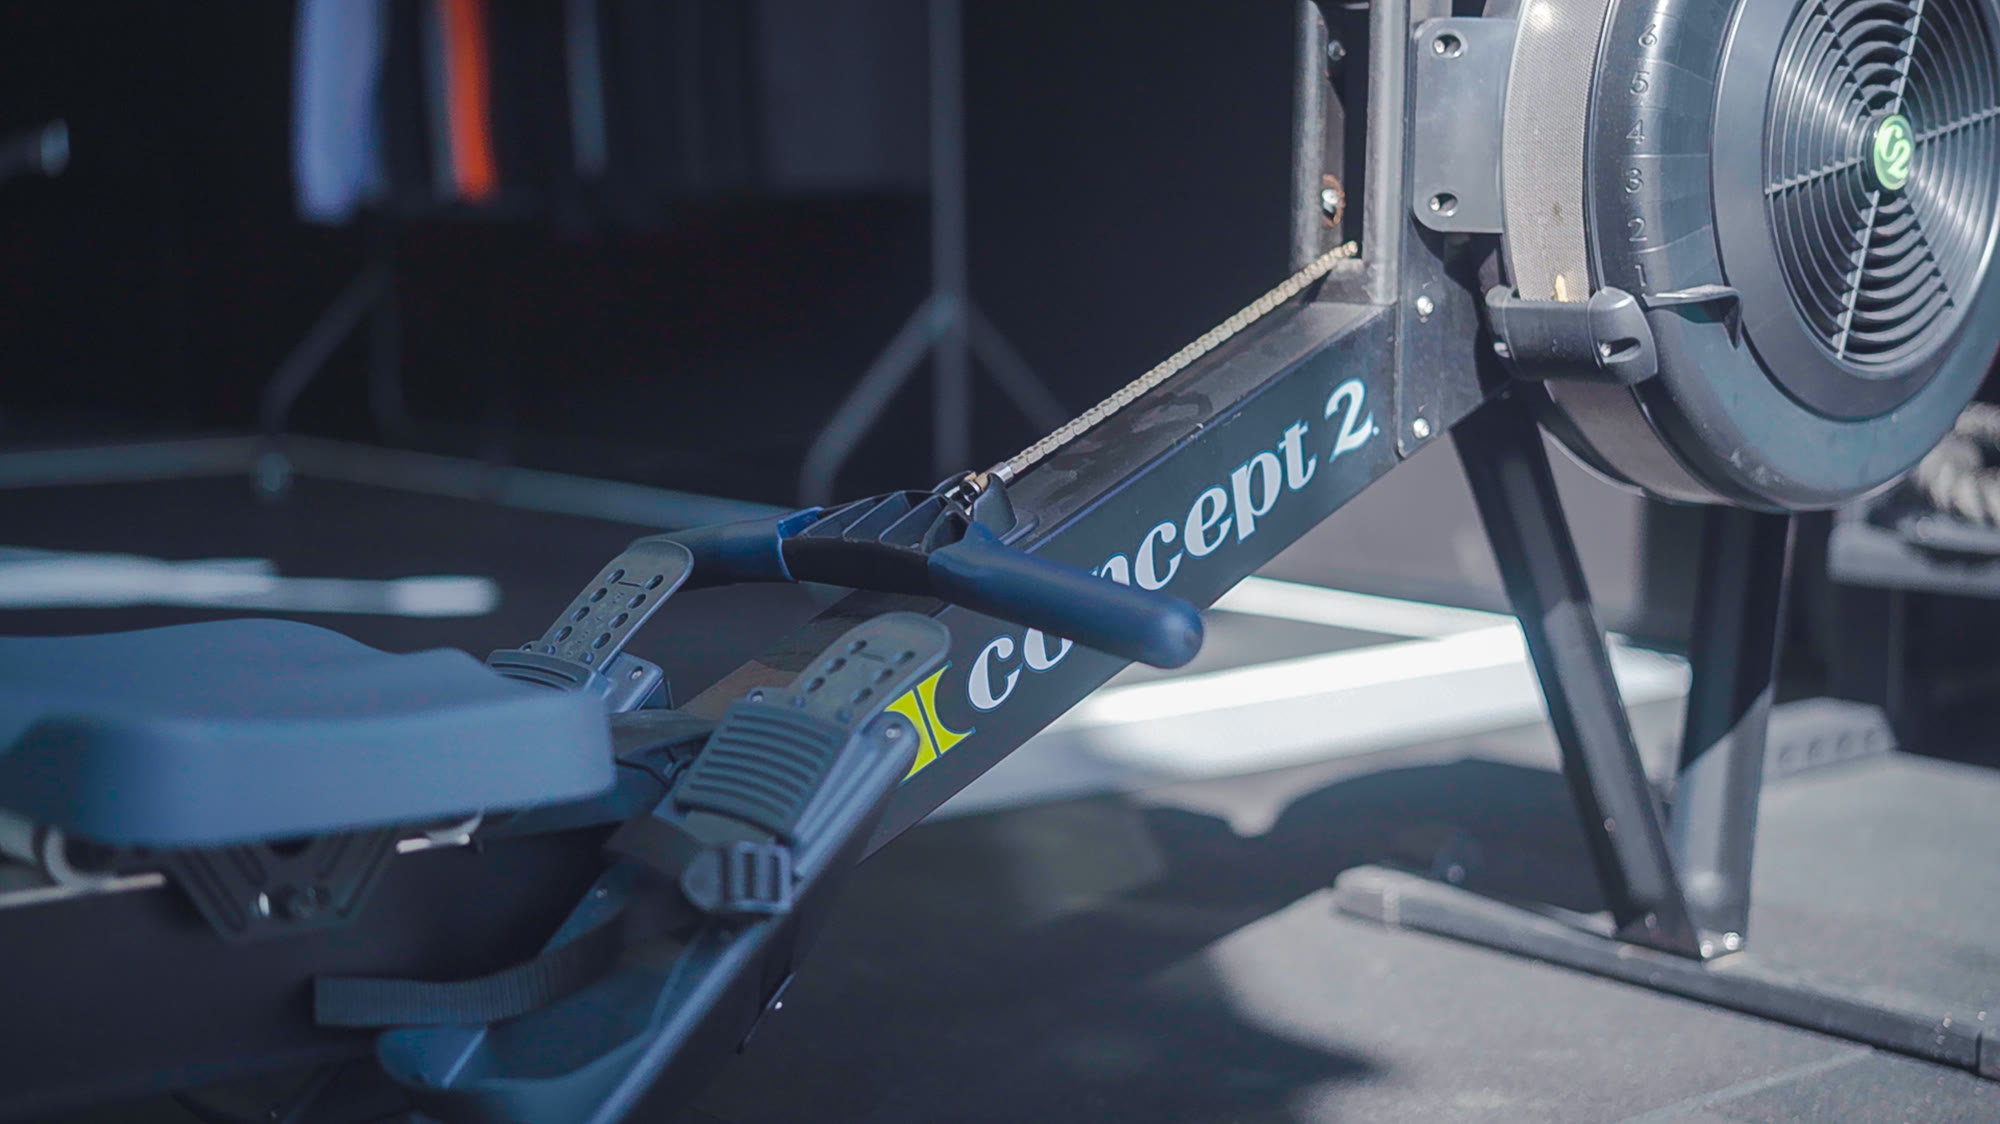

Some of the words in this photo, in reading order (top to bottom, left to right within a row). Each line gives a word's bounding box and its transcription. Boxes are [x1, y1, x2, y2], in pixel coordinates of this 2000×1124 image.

[1637, 23, 1658, 48] 6
[1629, 71, 1650, 96] 5
[1625, 119, 1646, 145] 4
[1624, 167, 1644, 194] 3
[1627, 217, 1648, 242] 2
